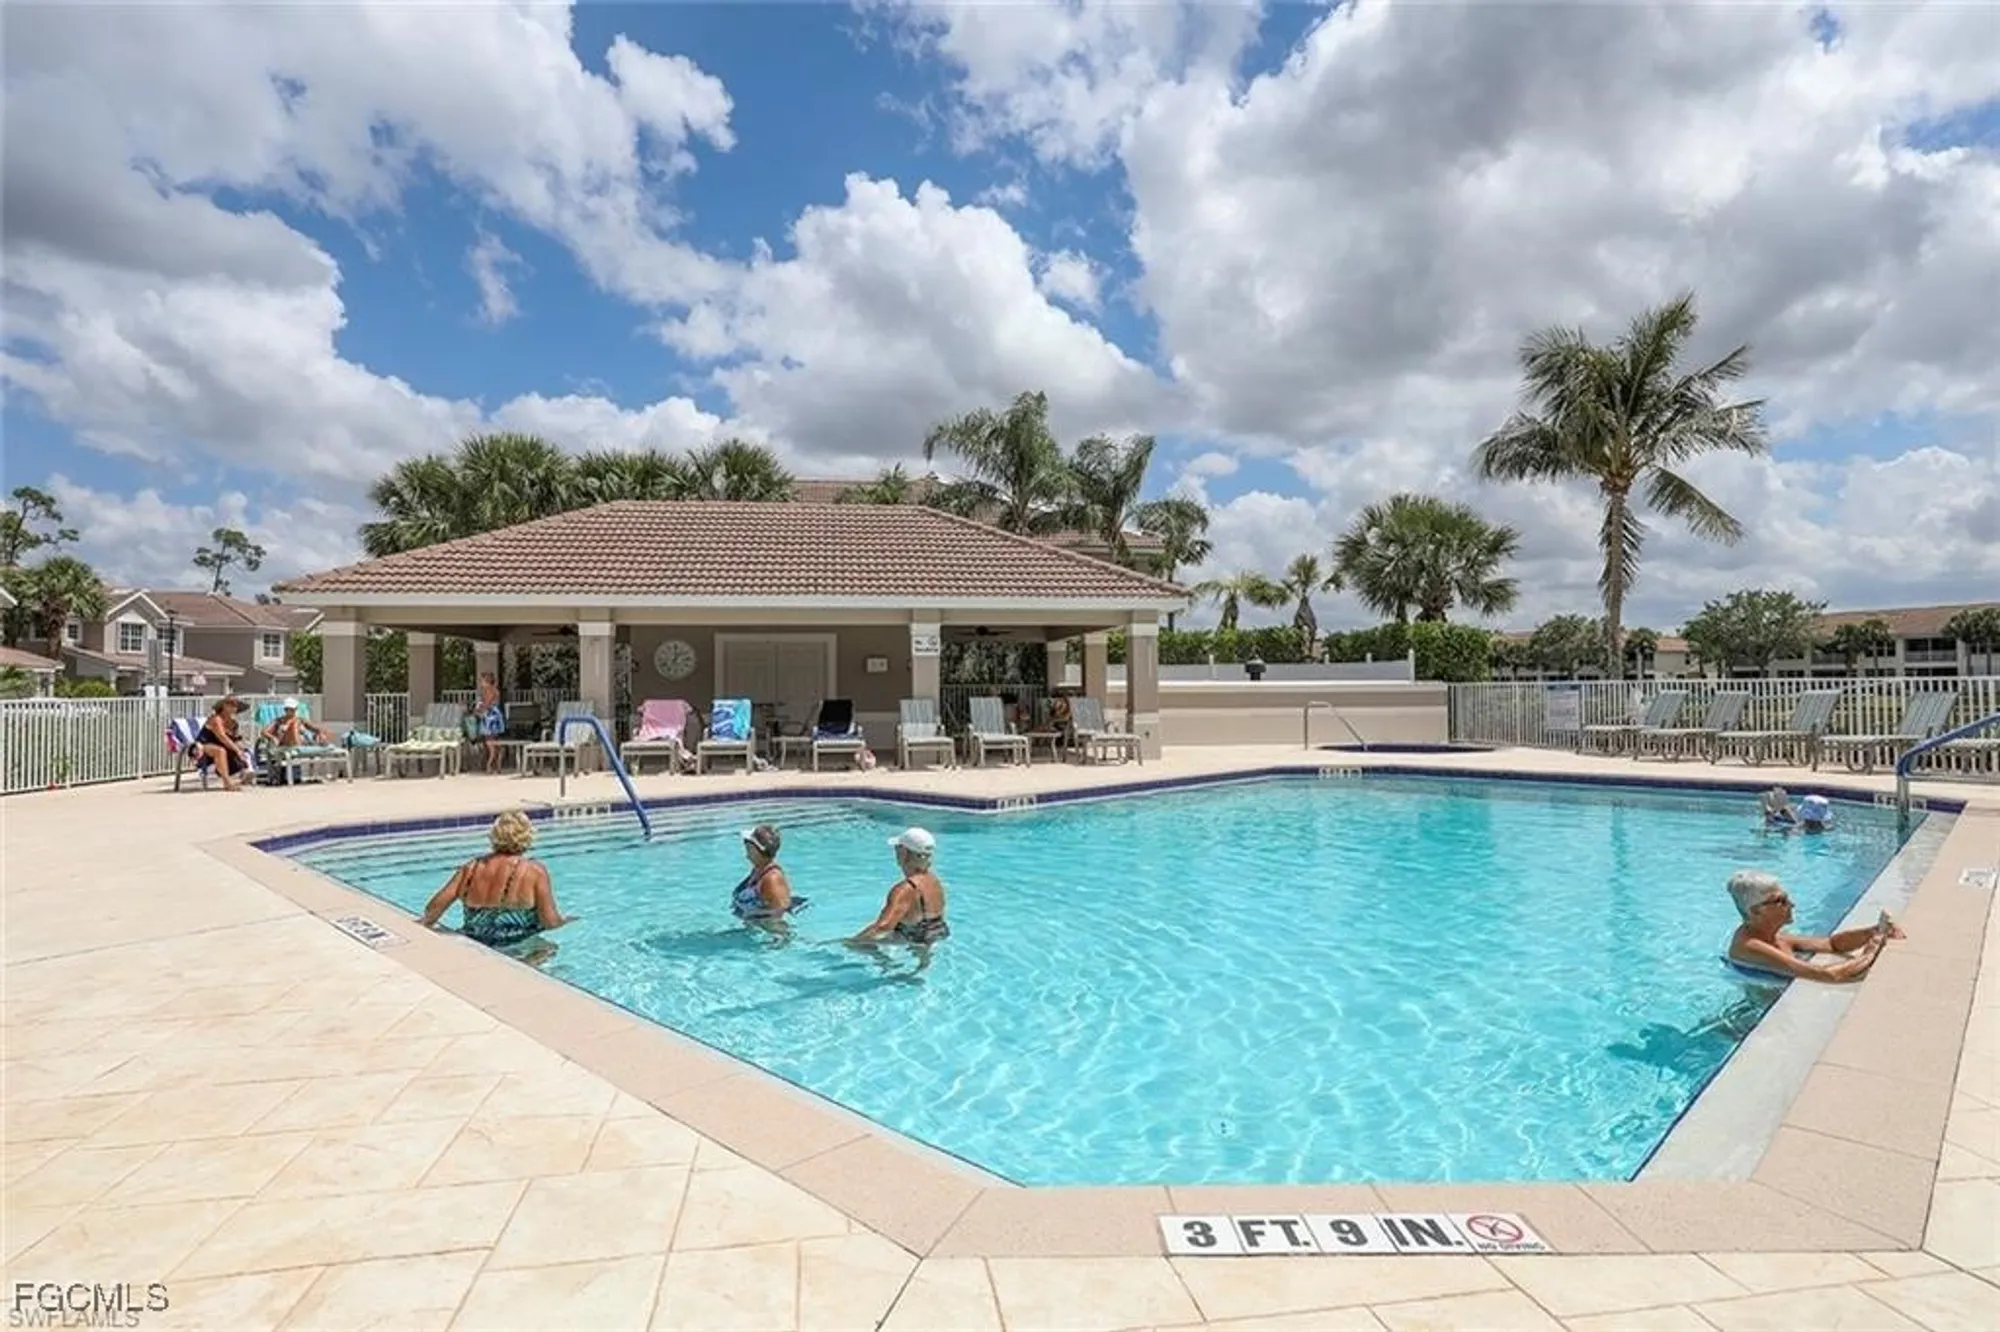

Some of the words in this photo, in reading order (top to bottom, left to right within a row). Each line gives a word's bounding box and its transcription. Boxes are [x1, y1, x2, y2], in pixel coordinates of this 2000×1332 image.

[1183, 1220, 1217, 1248] 3
[1238, 1219, 1311, 1247] FT.
[1329, 1219, 1368, 1246] 9
[1383, 1218, 1464, 1246] IN.
